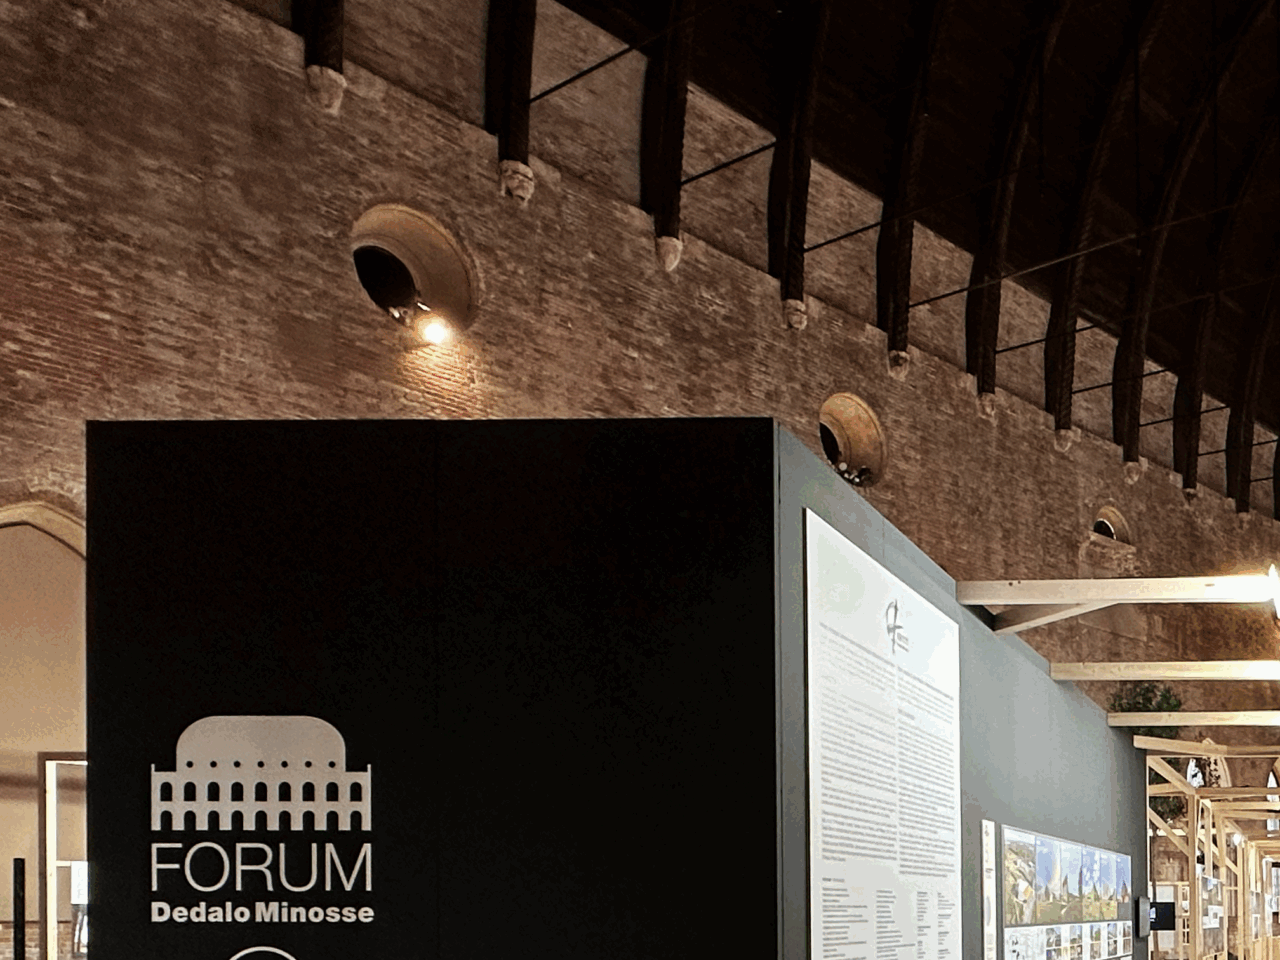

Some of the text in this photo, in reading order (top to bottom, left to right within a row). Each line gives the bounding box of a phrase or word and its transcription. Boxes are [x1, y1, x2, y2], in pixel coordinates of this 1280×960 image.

[151, 841, 372, 892] FORUM
[151, 901, 375, 923] Dedalo Minosse
